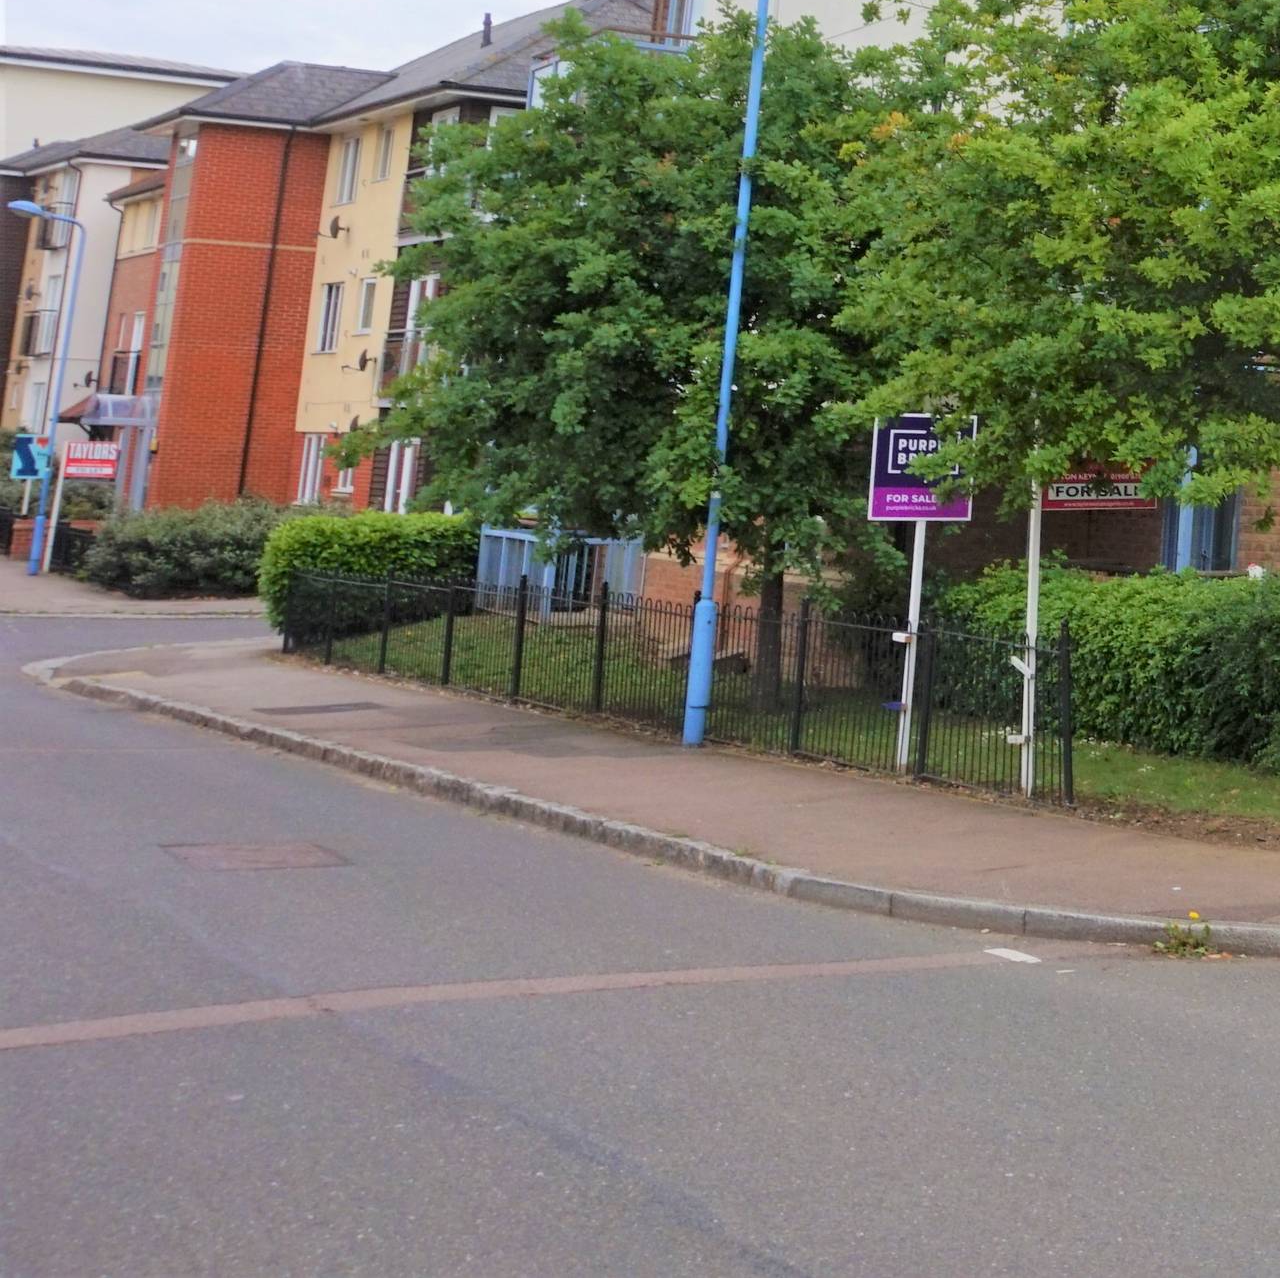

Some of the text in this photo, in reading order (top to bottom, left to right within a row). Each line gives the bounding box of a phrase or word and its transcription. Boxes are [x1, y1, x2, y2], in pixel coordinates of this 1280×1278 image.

[68, 442, 117, 459] TAYLORS
[898, 438, 942, 451] PURP
[1055, 485, 1091, 497] FOR
[886, 494, 909, 503] FOR
